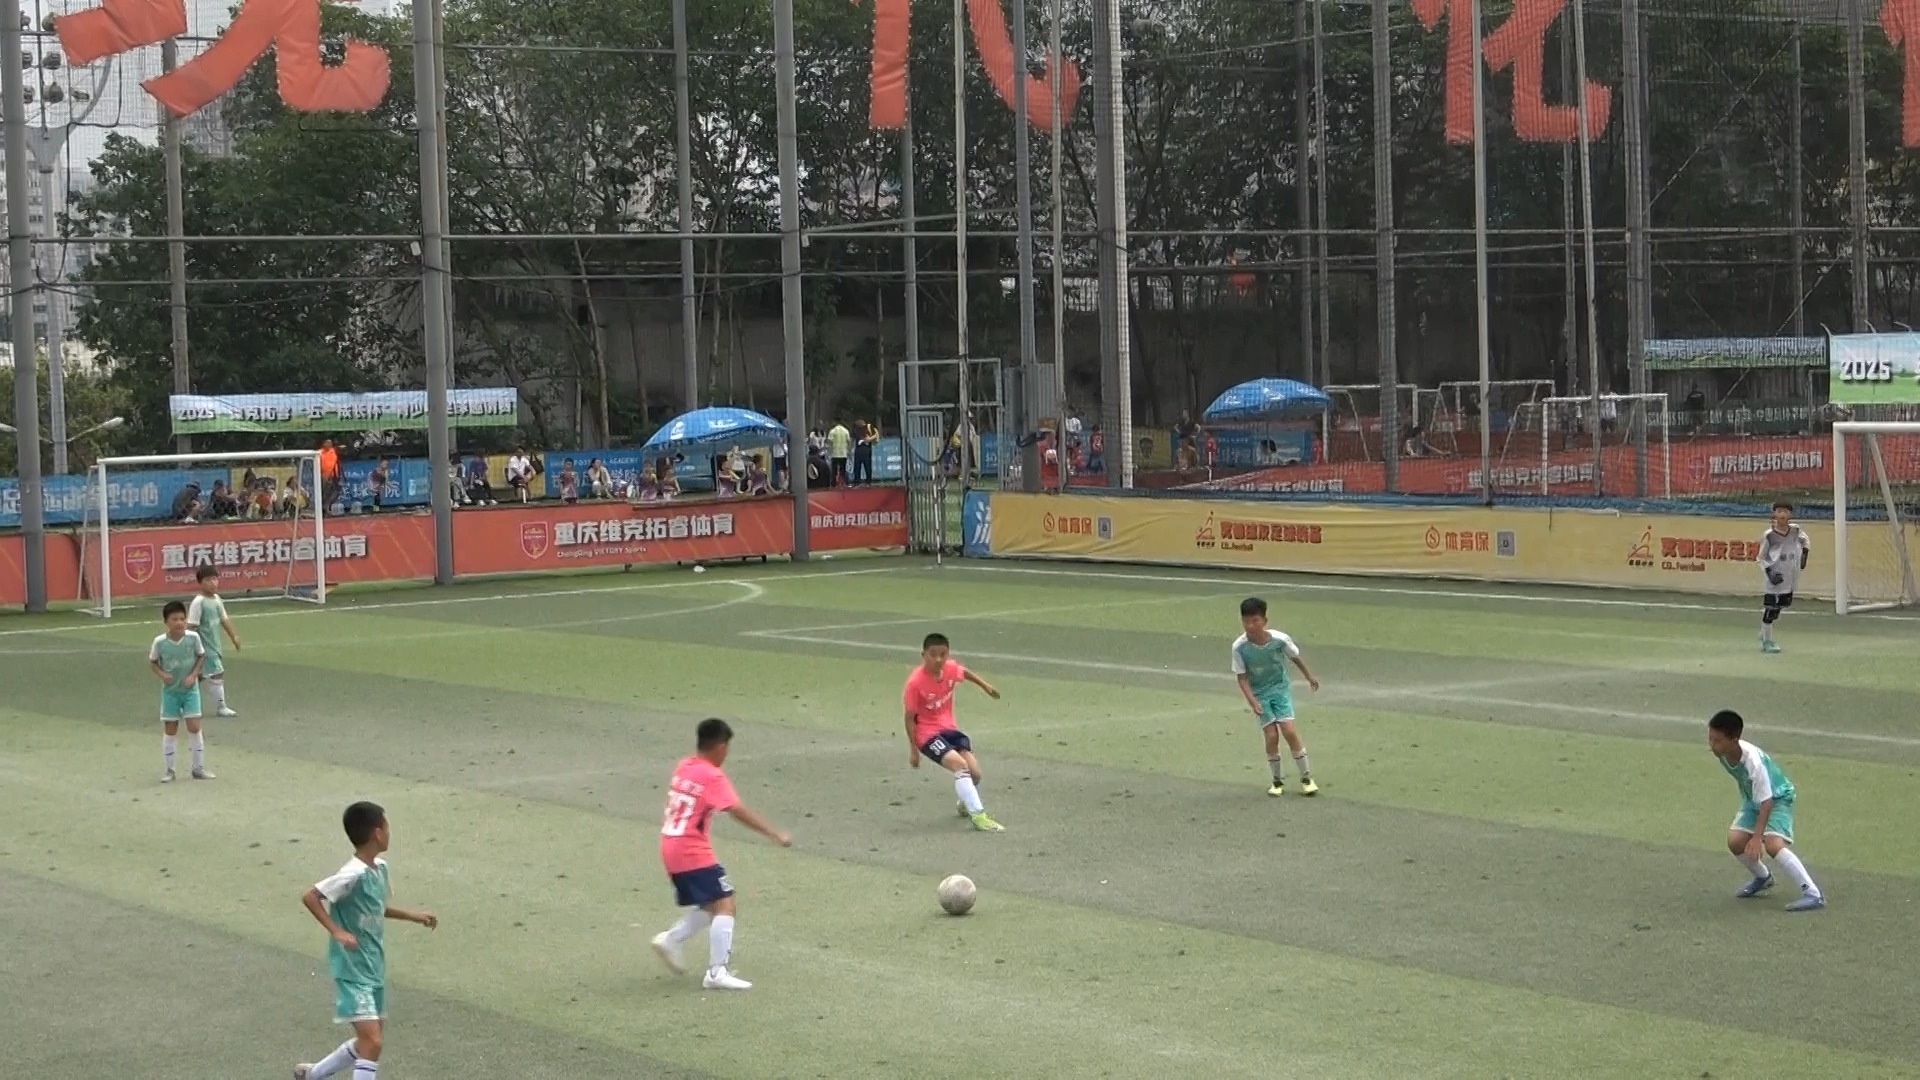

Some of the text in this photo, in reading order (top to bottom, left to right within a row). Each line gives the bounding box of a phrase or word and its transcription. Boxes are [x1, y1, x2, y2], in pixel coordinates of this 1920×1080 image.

[1839, 359, 1892, 383] 2025
[554, 513, 733, 546] 重庆维克拓睿体育
[1445, 531, 1489, 551] 体育保
[161, 535, 367, 570] 重庆维克拓睿体育
